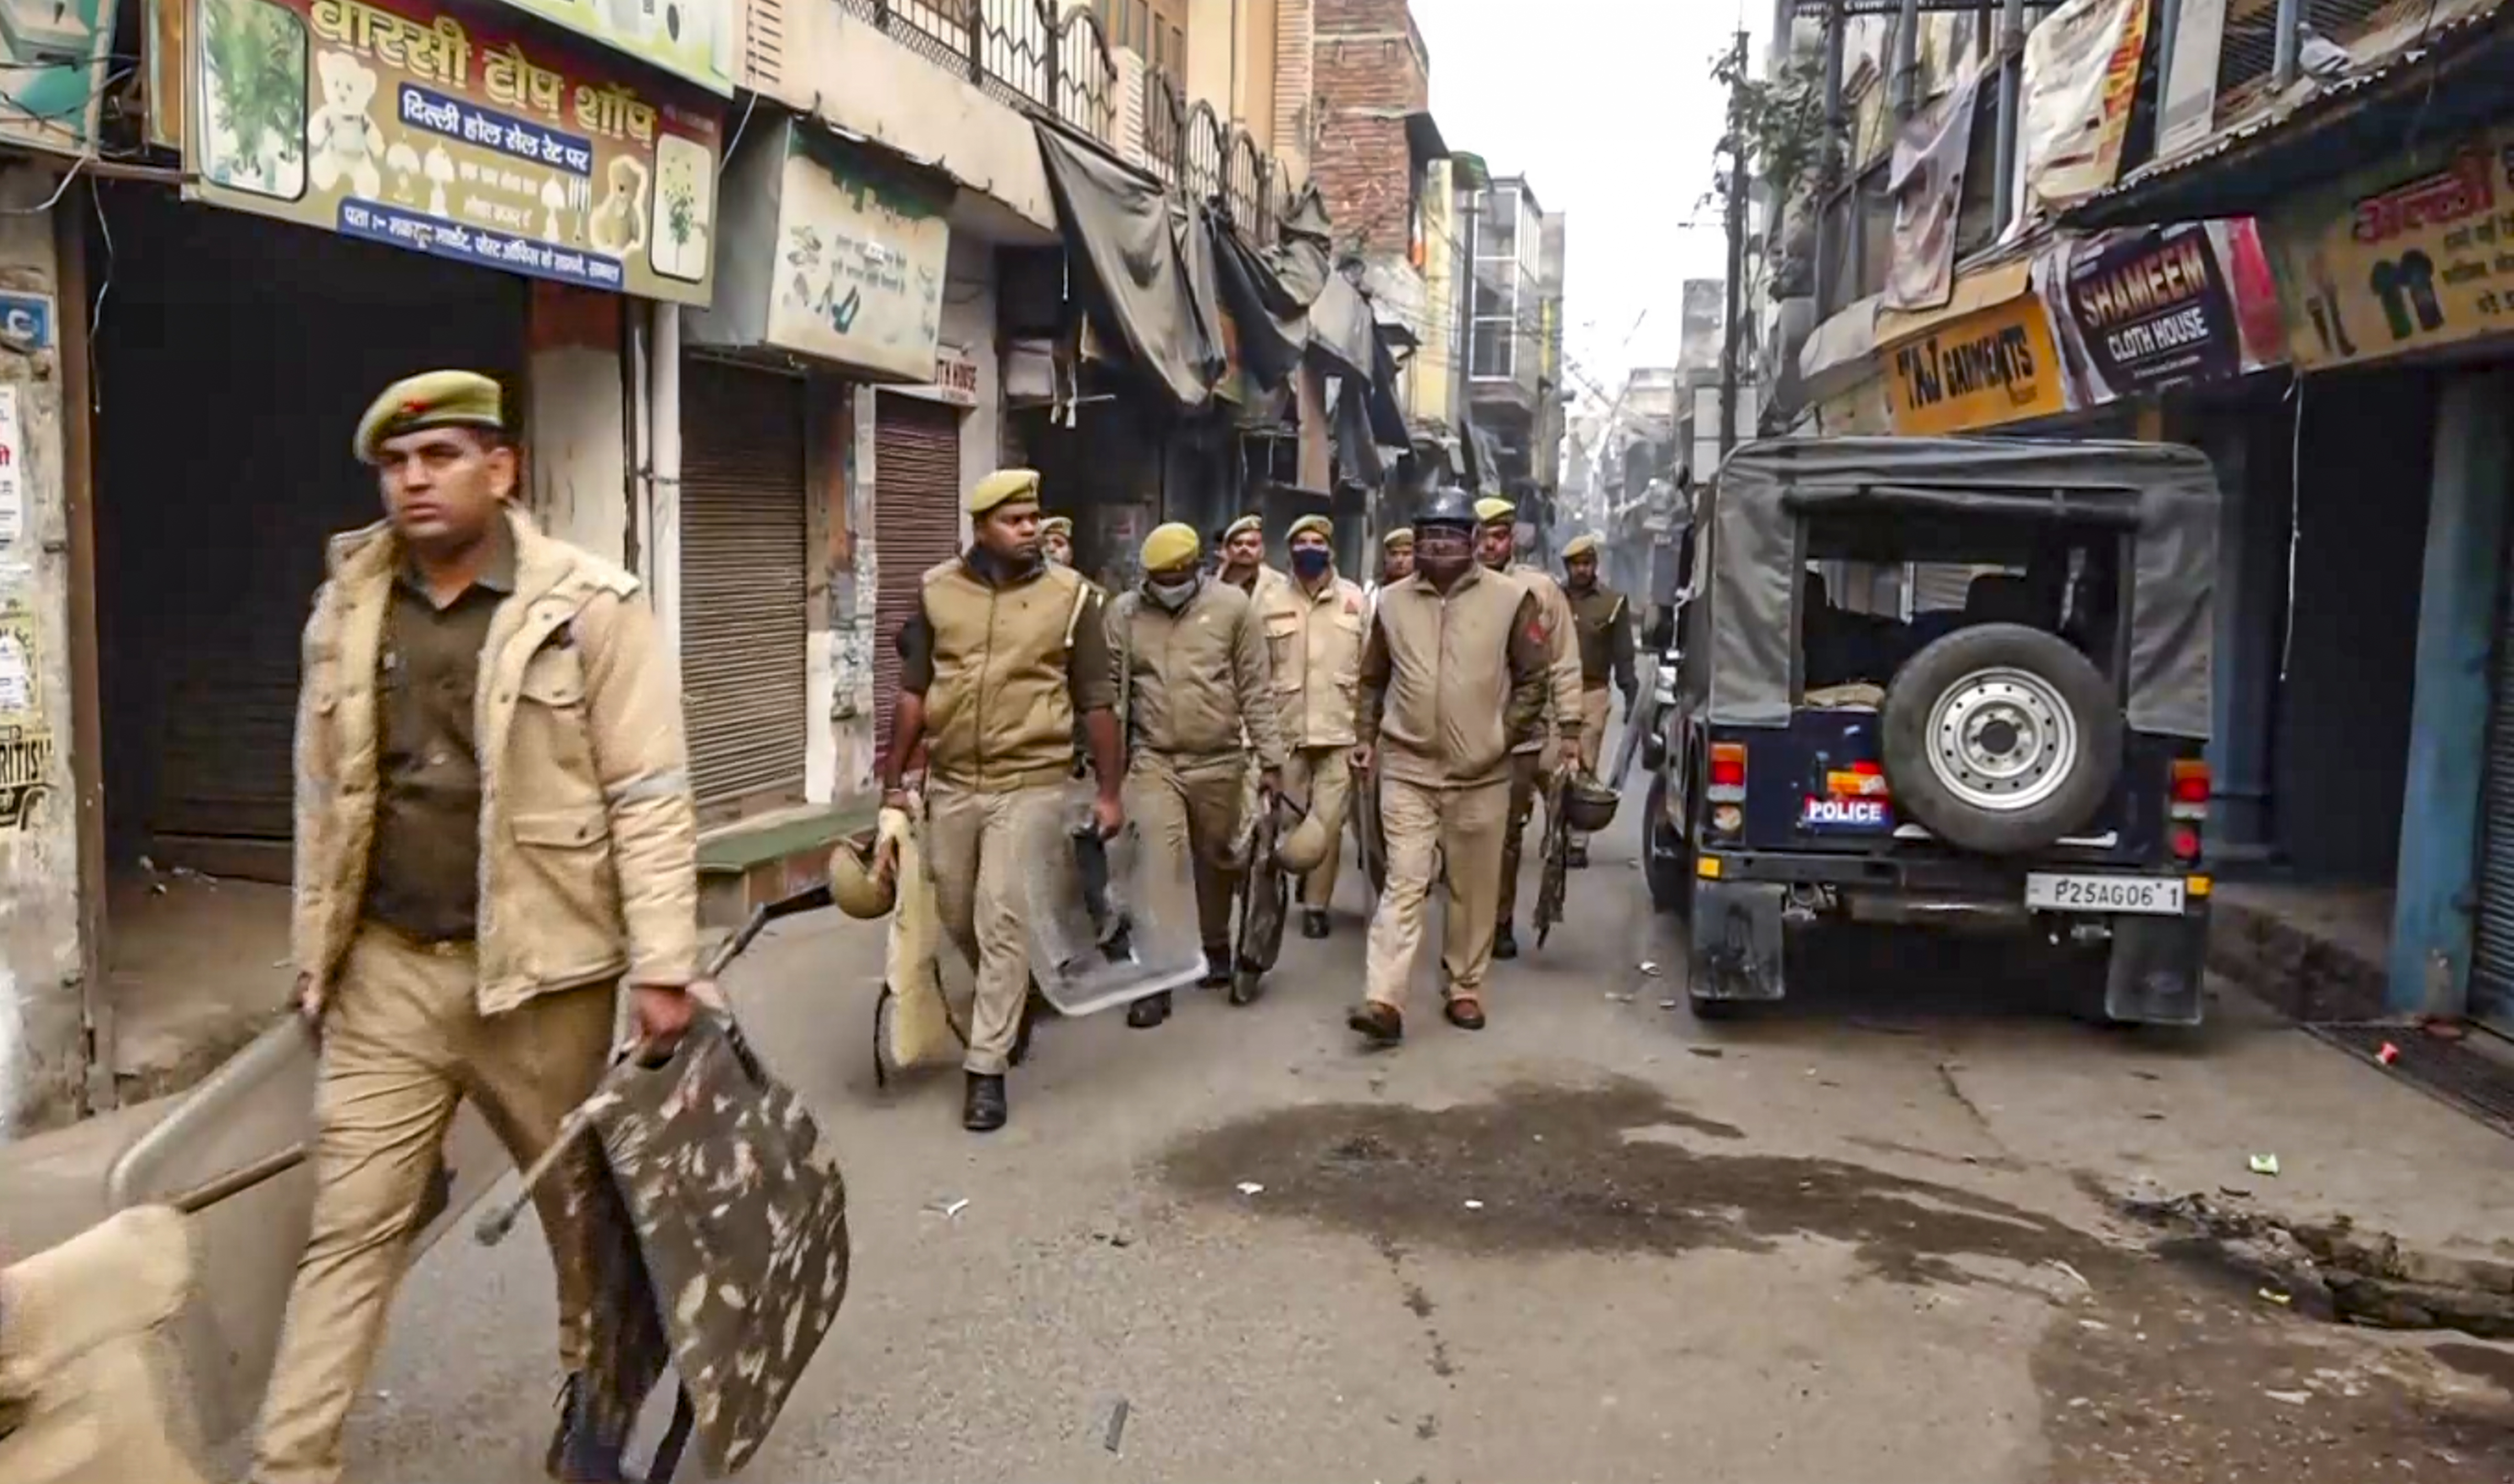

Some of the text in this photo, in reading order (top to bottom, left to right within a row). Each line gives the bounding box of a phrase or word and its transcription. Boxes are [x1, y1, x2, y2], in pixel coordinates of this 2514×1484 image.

[403, 89, 590, 172] दिल्ली होल सेल रेट पर
[2079, 238, 2207, 327] SHAMEEM
[2107, 306, 2209, 362] CLOTH HOUSE
[1809, 799, 1883, 821] POLICE
